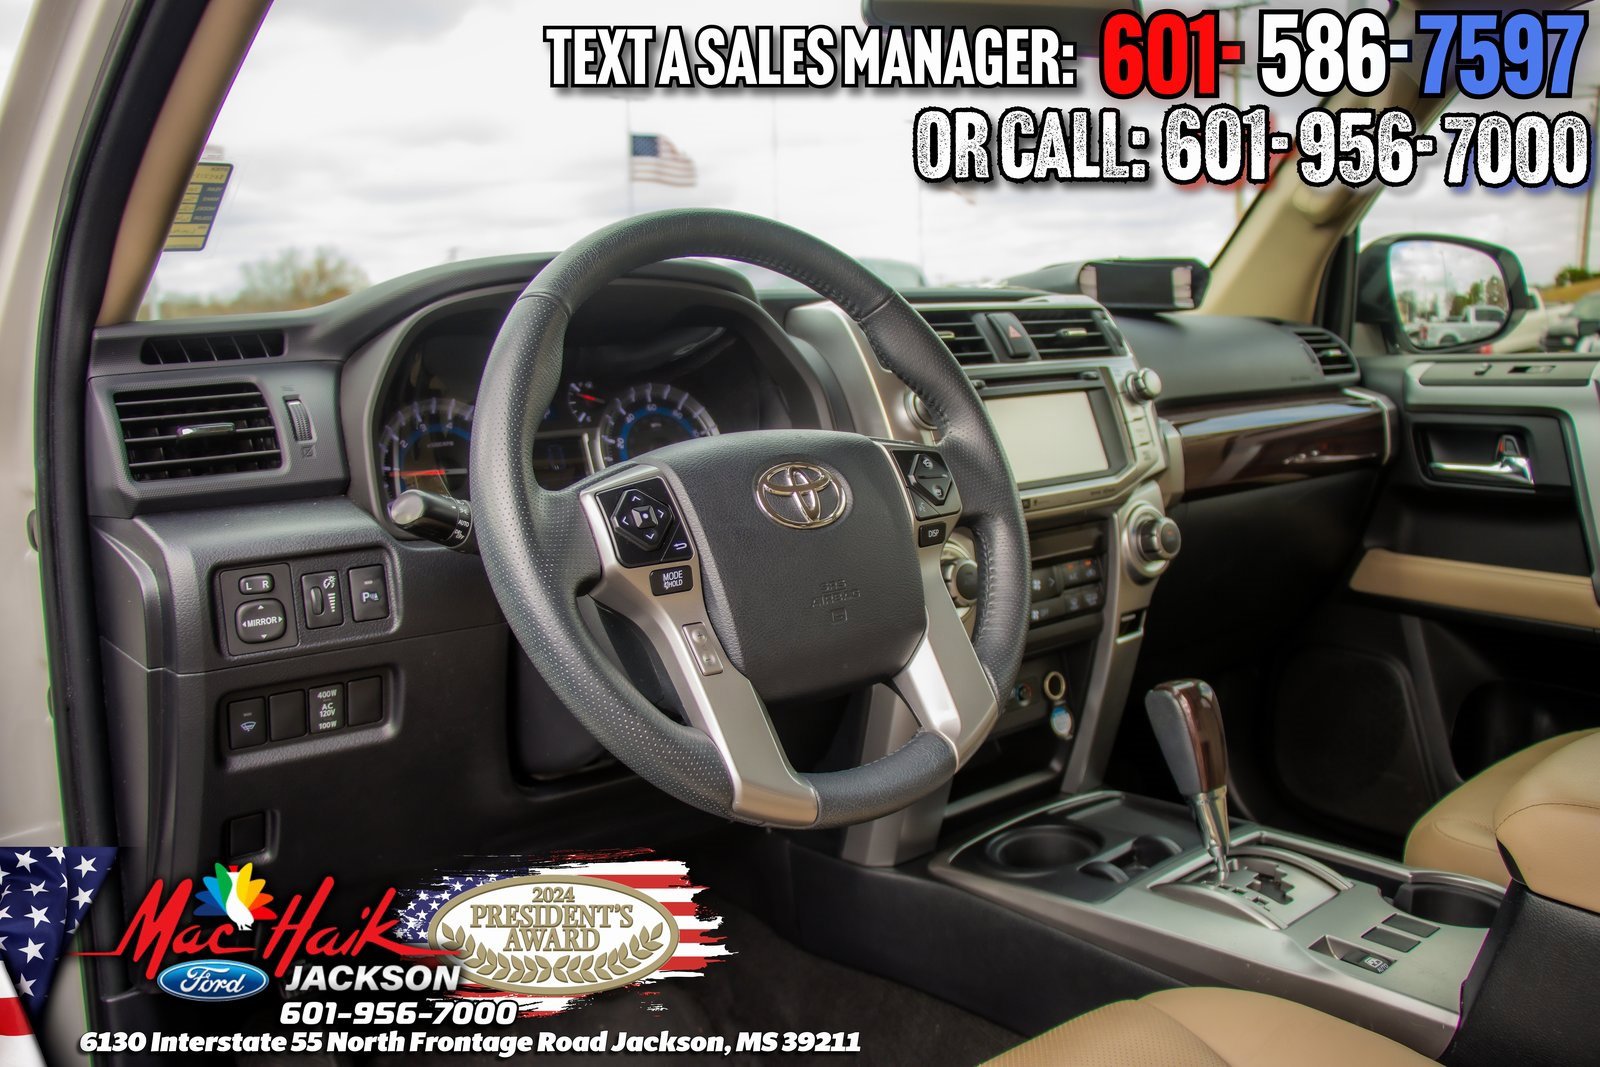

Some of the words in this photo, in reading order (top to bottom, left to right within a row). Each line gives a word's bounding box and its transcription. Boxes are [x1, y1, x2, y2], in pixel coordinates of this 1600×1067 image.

[457, 519, 470, 528] AUTO
[928, 528, 940, 538] DISP
[662, 569, 683, 582] MODE
[246, 582, 252, 591] L
[262, 580, 269, 589] R
[668, 579, 683, 589] HOLD
[247, 616, 278, 628] MIRROR
[317, 689, 338, 699] 400W
[322, 702, 334, 711] AC
[319, 709, 336, 718] 120V
[318, 720, 338, 730] 100W
